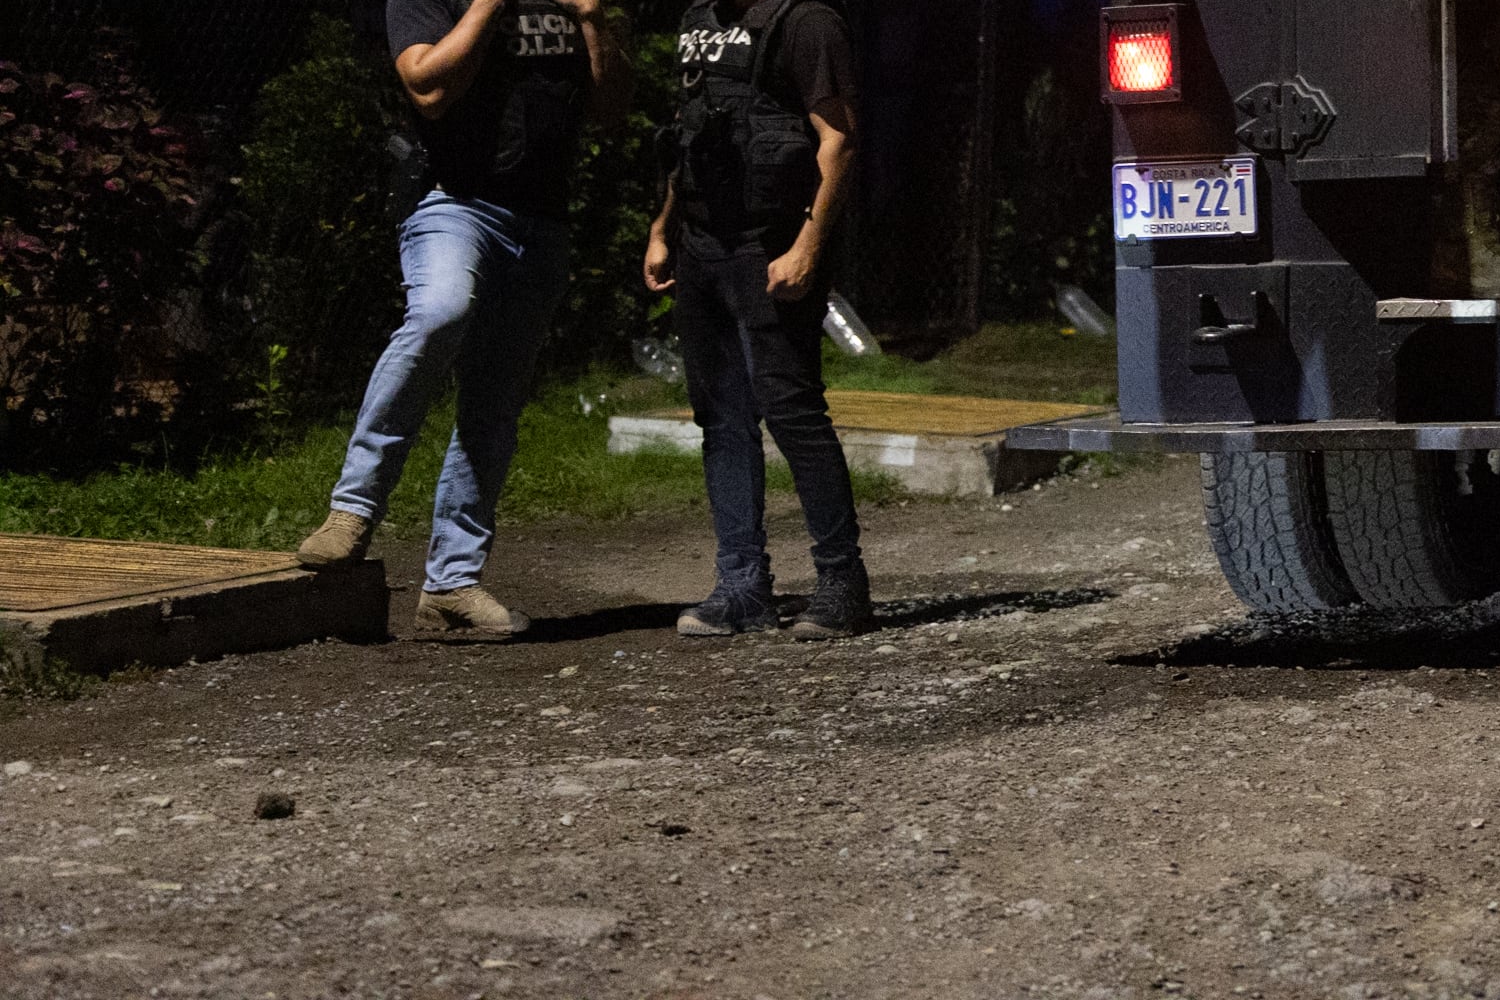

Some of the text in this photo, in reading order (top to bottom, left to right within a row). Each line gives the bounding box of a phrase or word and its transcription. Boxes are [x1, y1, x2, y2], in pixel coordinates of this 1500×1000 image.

[678, 27, 752, 53] POLICIA
[1152, 168, 1216, 180] COSTA RICA
[1121, 178, 1247, 219] BJN-221
[1143, 221, 1231, 235] CENTROAMERICA
